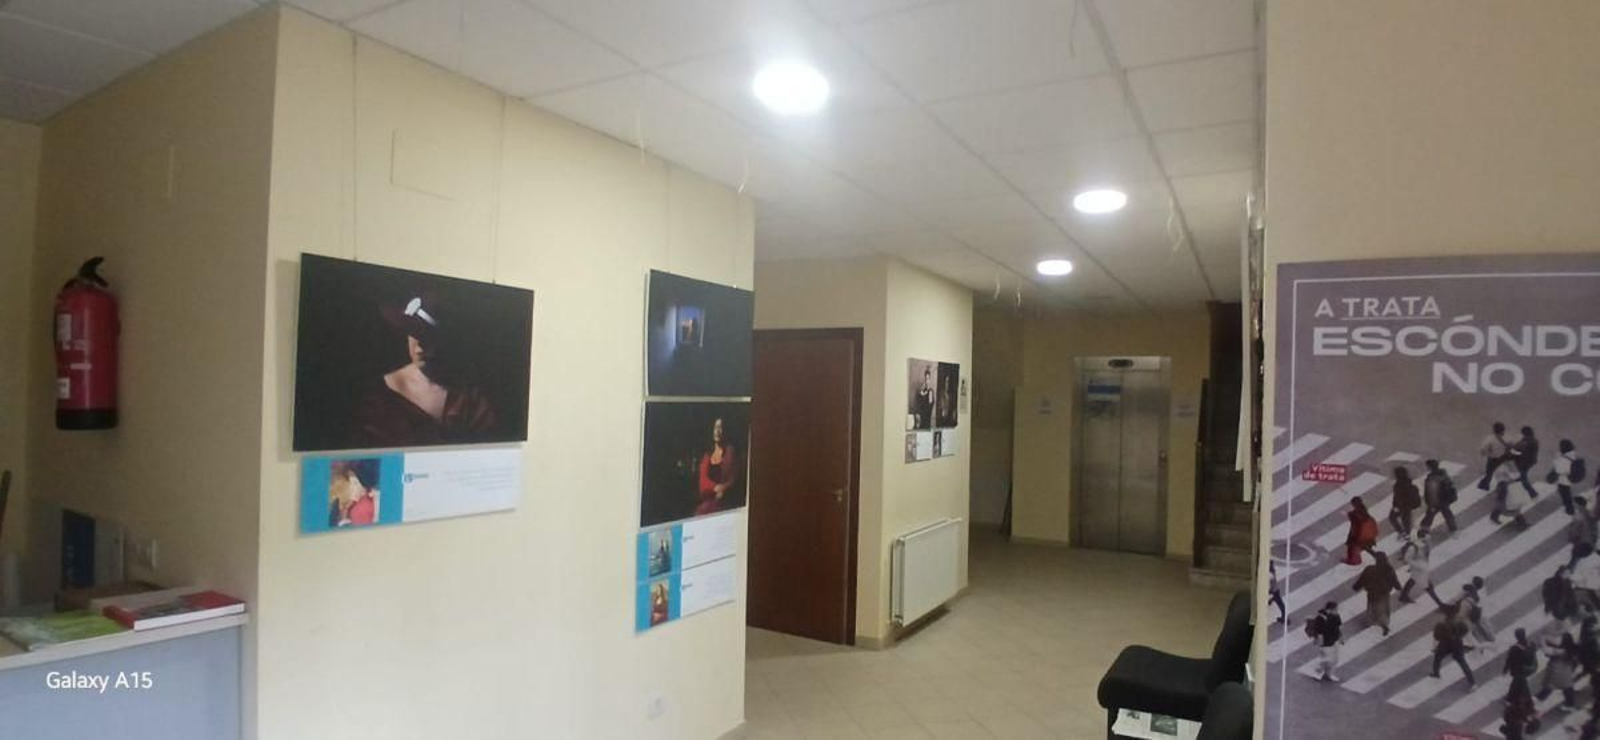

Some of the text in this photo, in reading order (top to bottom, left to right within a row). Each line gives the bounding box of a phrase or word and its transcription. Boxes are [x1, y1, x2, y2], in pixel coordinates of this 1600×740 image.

[1314, 296, 1440, 318] A TRATA
[1313, 314, 1600, 356] ESCÓNDE
[1432, 362, 1600, 395] NO C
[1303, 470, 1345, 481] de trata
